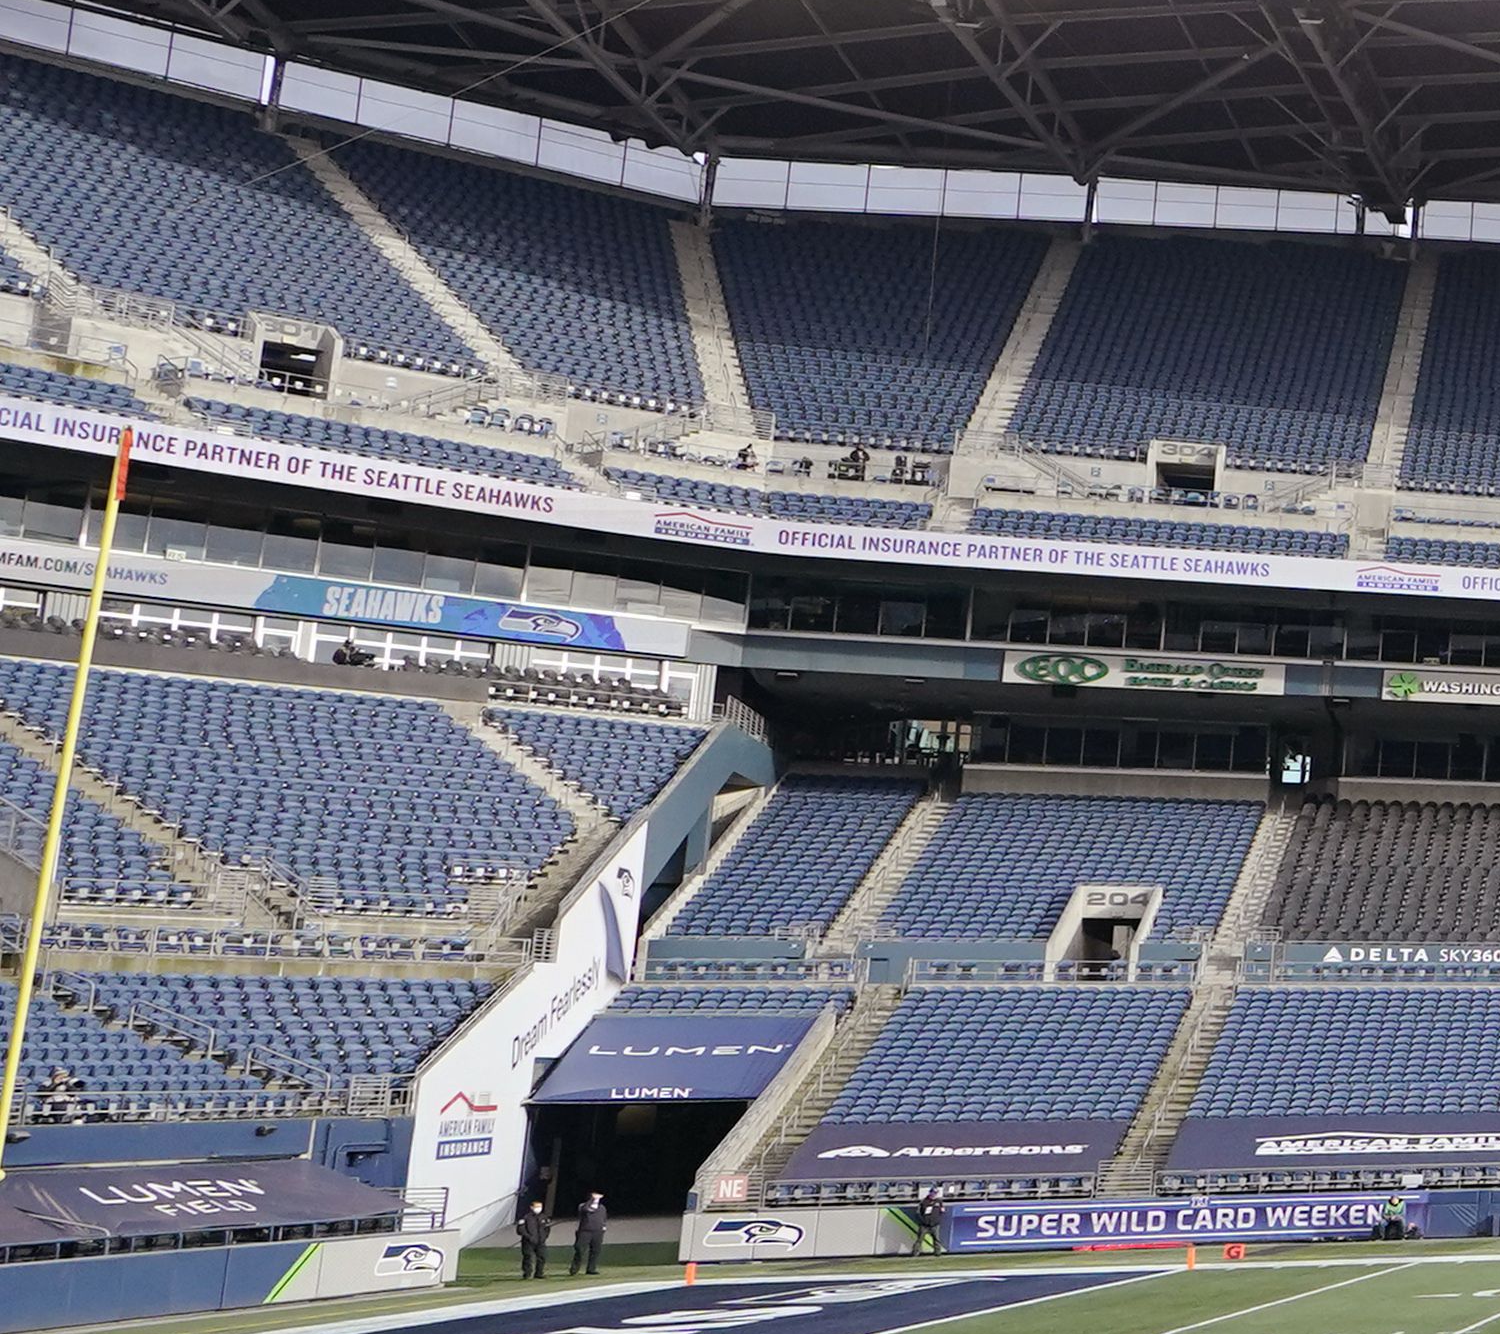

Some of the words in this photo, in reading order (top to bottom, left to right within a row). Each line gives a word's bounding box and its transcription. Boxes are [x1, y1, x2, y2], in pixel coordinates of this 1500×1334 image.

[53, 417, 178, 455] INSURANCE
[184, 439, 280, 471] PARTNER
[287, 455, 312, 475] OF
[320, 461, 357, 483] THE
[363, 467, 447, 497] SEATTLE
[452, 482, 553, 514] SEAHAWKS
[654, 517, 703, 535] AMERICAN
[706, 524, 751, 538] FAMILY
[778, 529, 856, 551] OFFICIAL
[862, 536, 962, 557] INSURANCE
[967, 543, 1043, 563] PARTNER
[1049, 548, 1068, 564] OF
[1074, 550, 1105, 566] THE
[1110, 552, 1178, 572] SEATTLE
[1184, 557, 1269, 578] SEAHAWKS
[321, 584, 446, 624] SEAHAWKS
[1086, 892, 1151, 907] 204
[511, 1024, 548, 1069] Dream
[550, 960, 601, 1026] Fearlessly
[589, 1044, 782, 1057] LUMEN
[610, 1087, 691, 1099] LUMEN
[439, 1119, 473, 1137] AMERICAN
[474, 1118, 496, 1134] FAMILY
[438, 1139, 492, 1159] INSURANCE
[899, 1143, 1087, 1158] Albertsons
[1257, 1135, 1401, 1151] AMERICAN
[80, 1179, 263, 1205] LUMEN
[719, 1178, 742, 1198] NE
[154, 1199, 257, 1216] FIELD
[976, 1212, 1080, 1238] SUPER
[1091, 1209, 1167, 1234] WILD
[1176, 1204, 1256, 1230] CARD
[1276, 1201, 1387, 1227] WEEKEN
